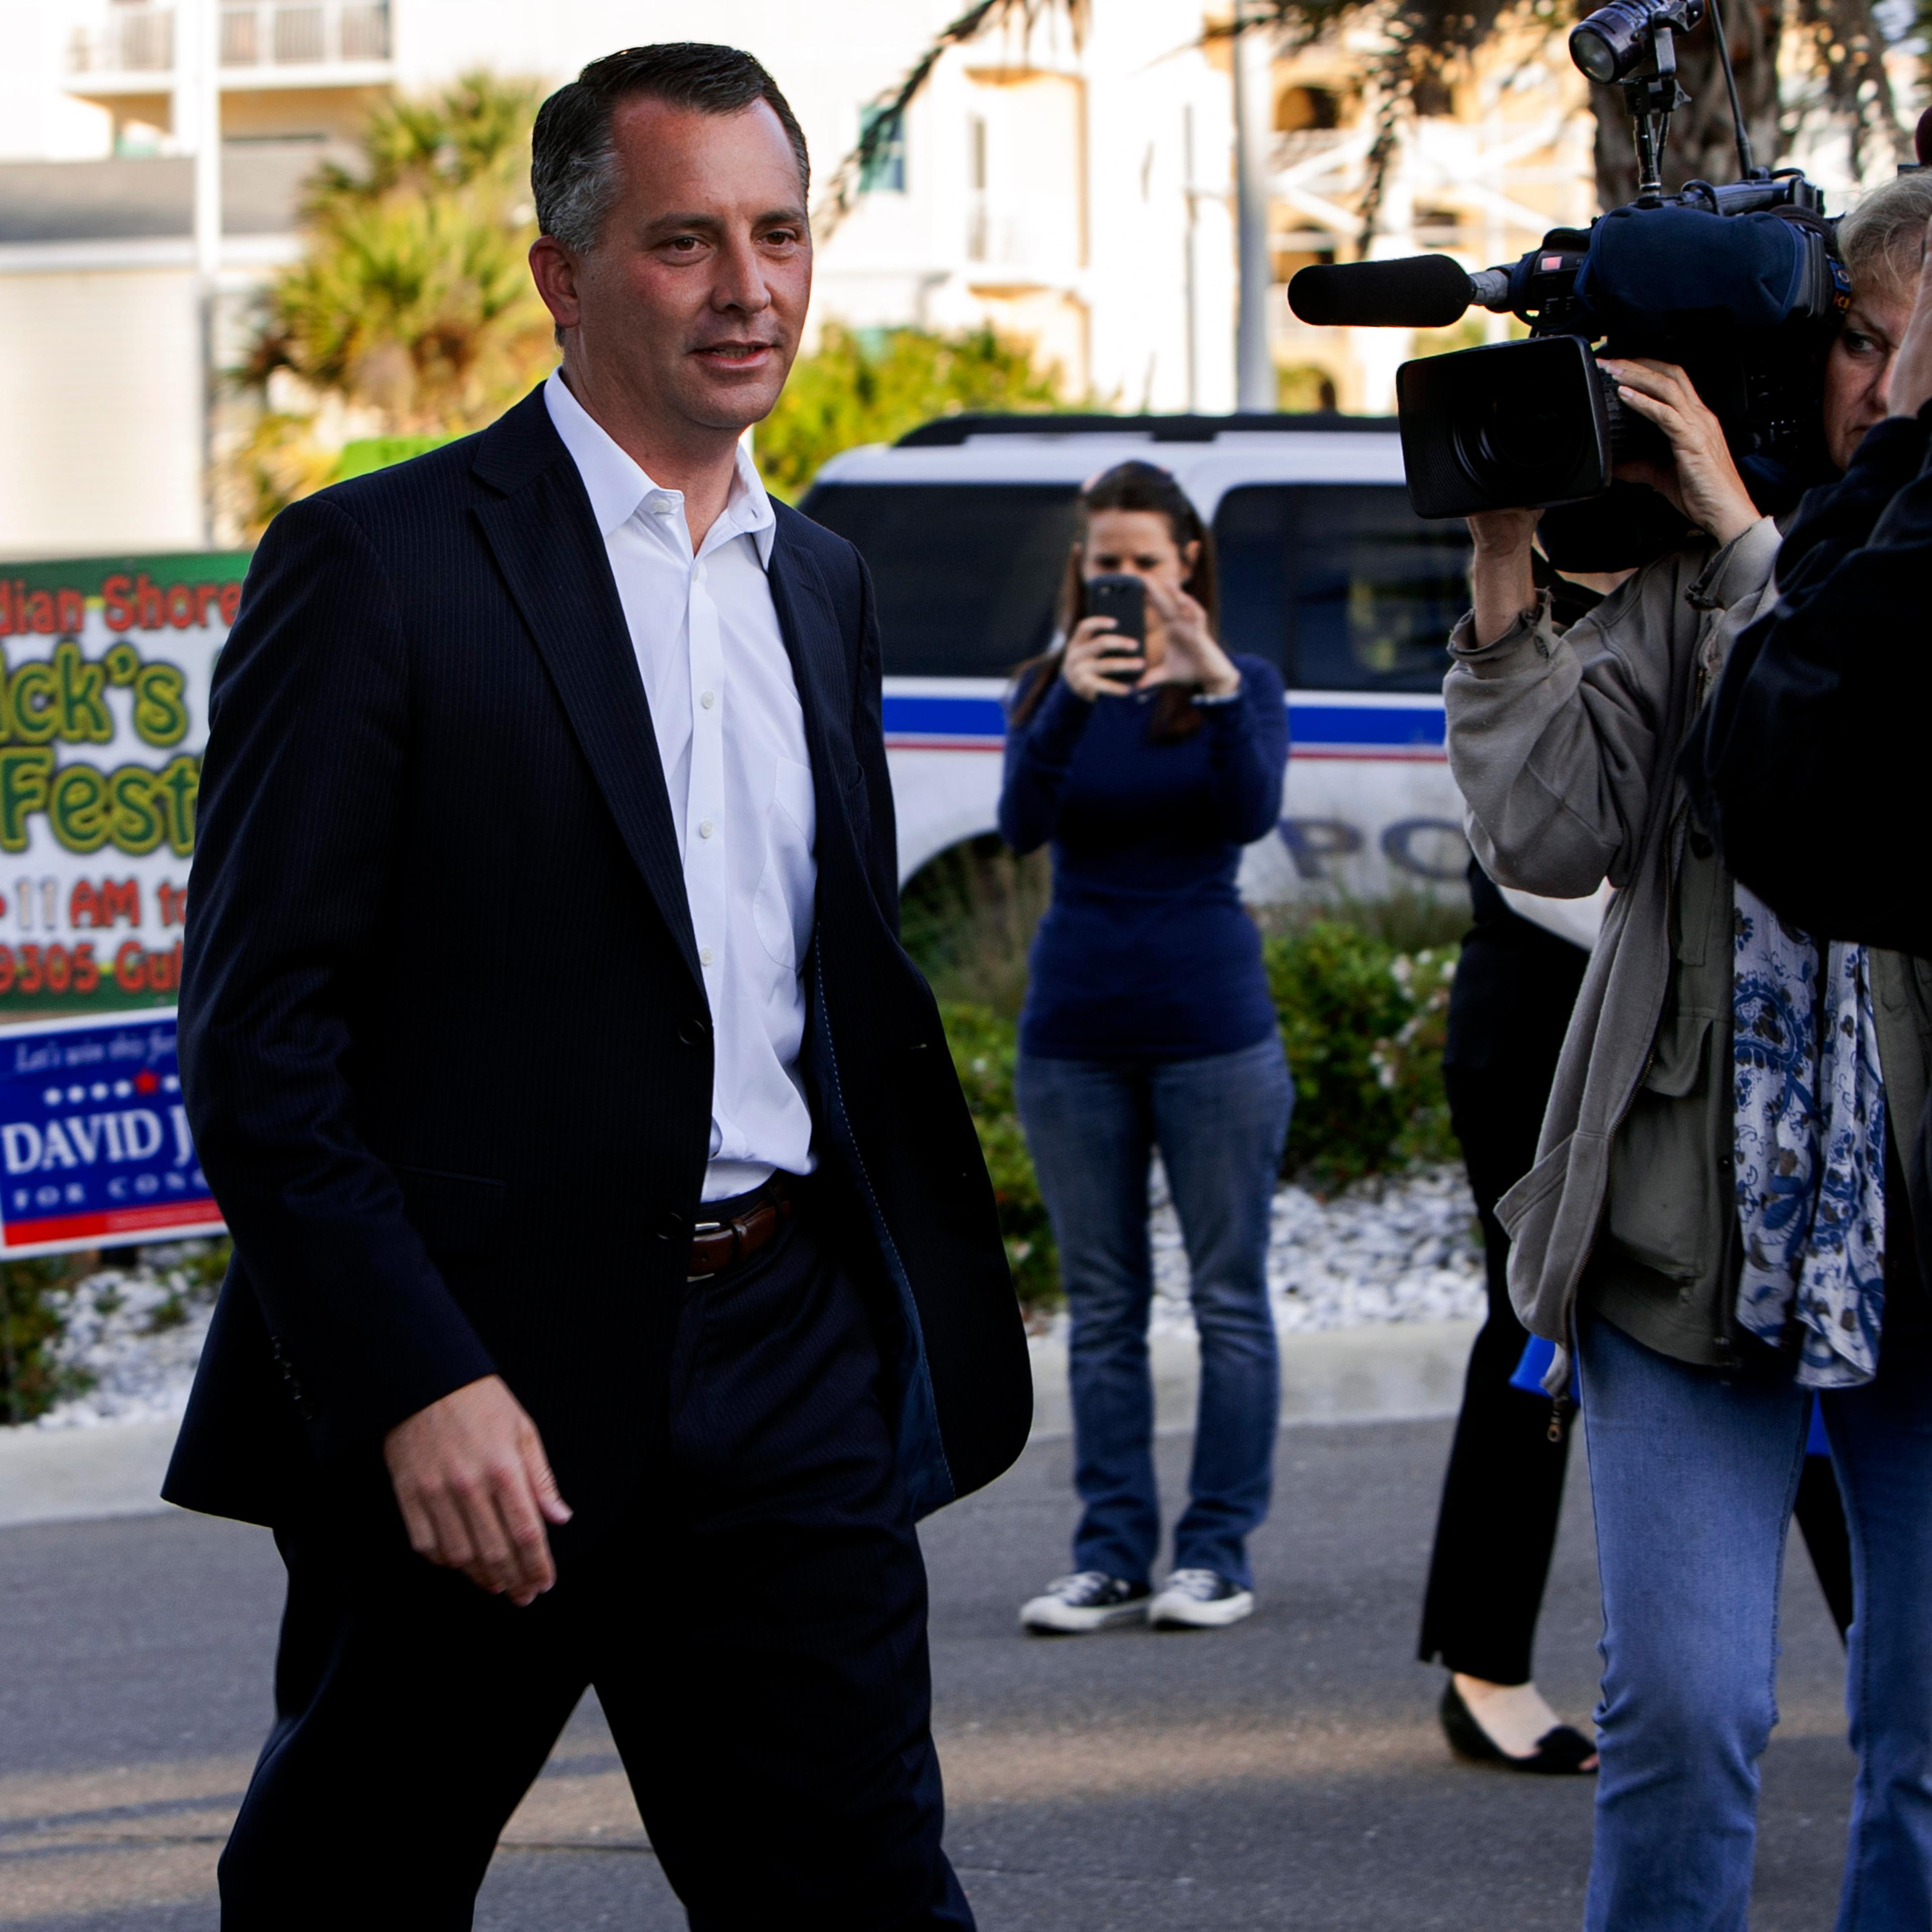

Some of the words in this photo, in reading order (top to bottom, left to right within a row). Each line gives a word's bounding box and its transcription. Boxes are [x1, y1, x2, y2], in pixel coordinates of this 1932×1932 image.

[69, 879, 141, 928] AM
[0, 1107, 164, 1176] DAVID
[12, 1182, 85, 1212] FOR
